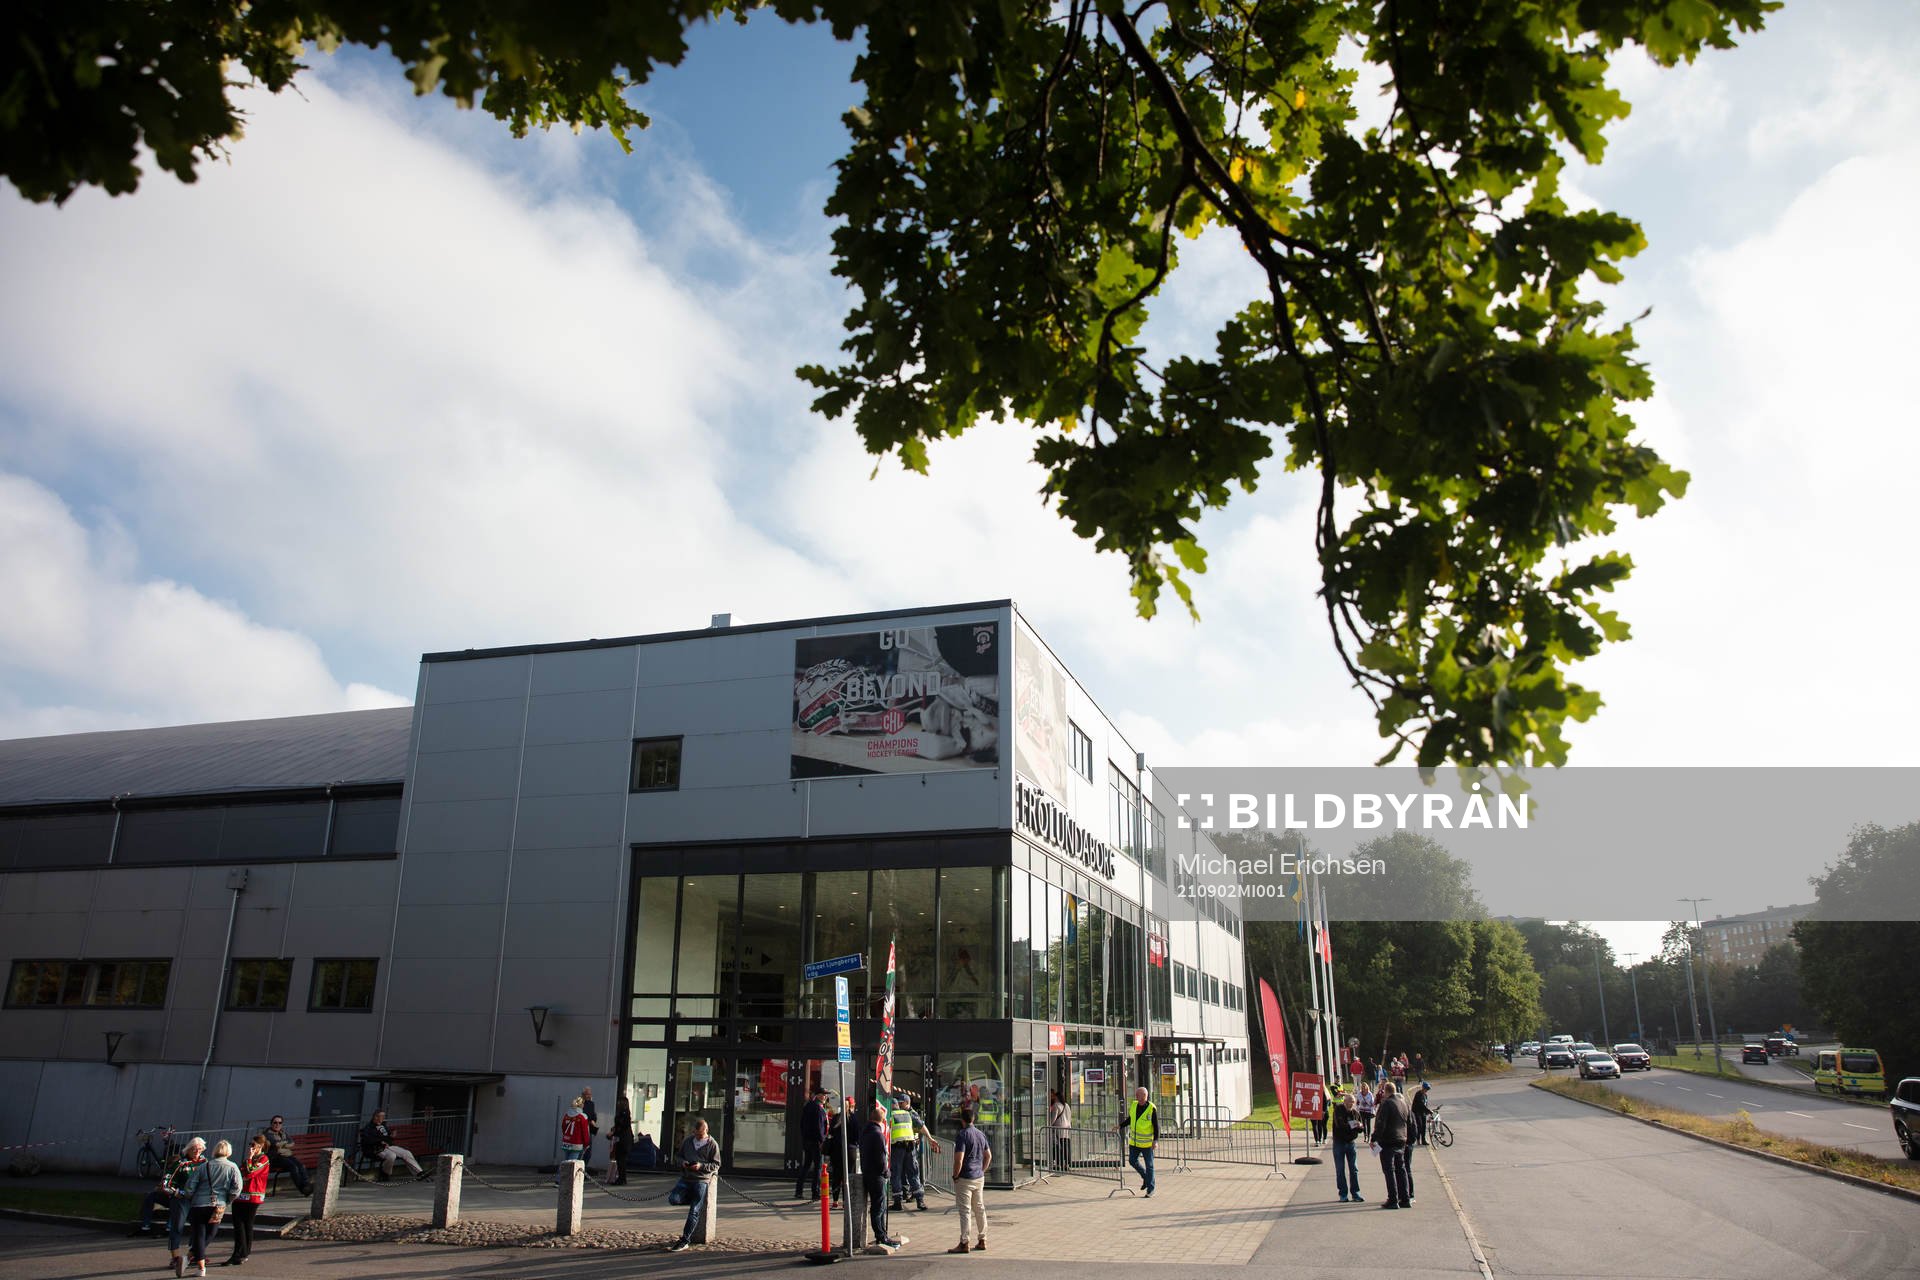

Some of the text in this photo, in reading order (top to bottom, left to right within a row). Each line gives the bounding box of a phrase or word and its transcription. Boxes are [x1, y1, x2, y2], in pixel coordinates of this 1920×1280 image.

[880, 629, 909, 650] GO
[847, 672, 940, 702] BEYOND
[883, 711, 904, 732] CHL
[867, 738, 918, 750] CHAMPIONS
[867, 750, 892, 758] HOCKEY
[840, 981, 846, 1004] P
